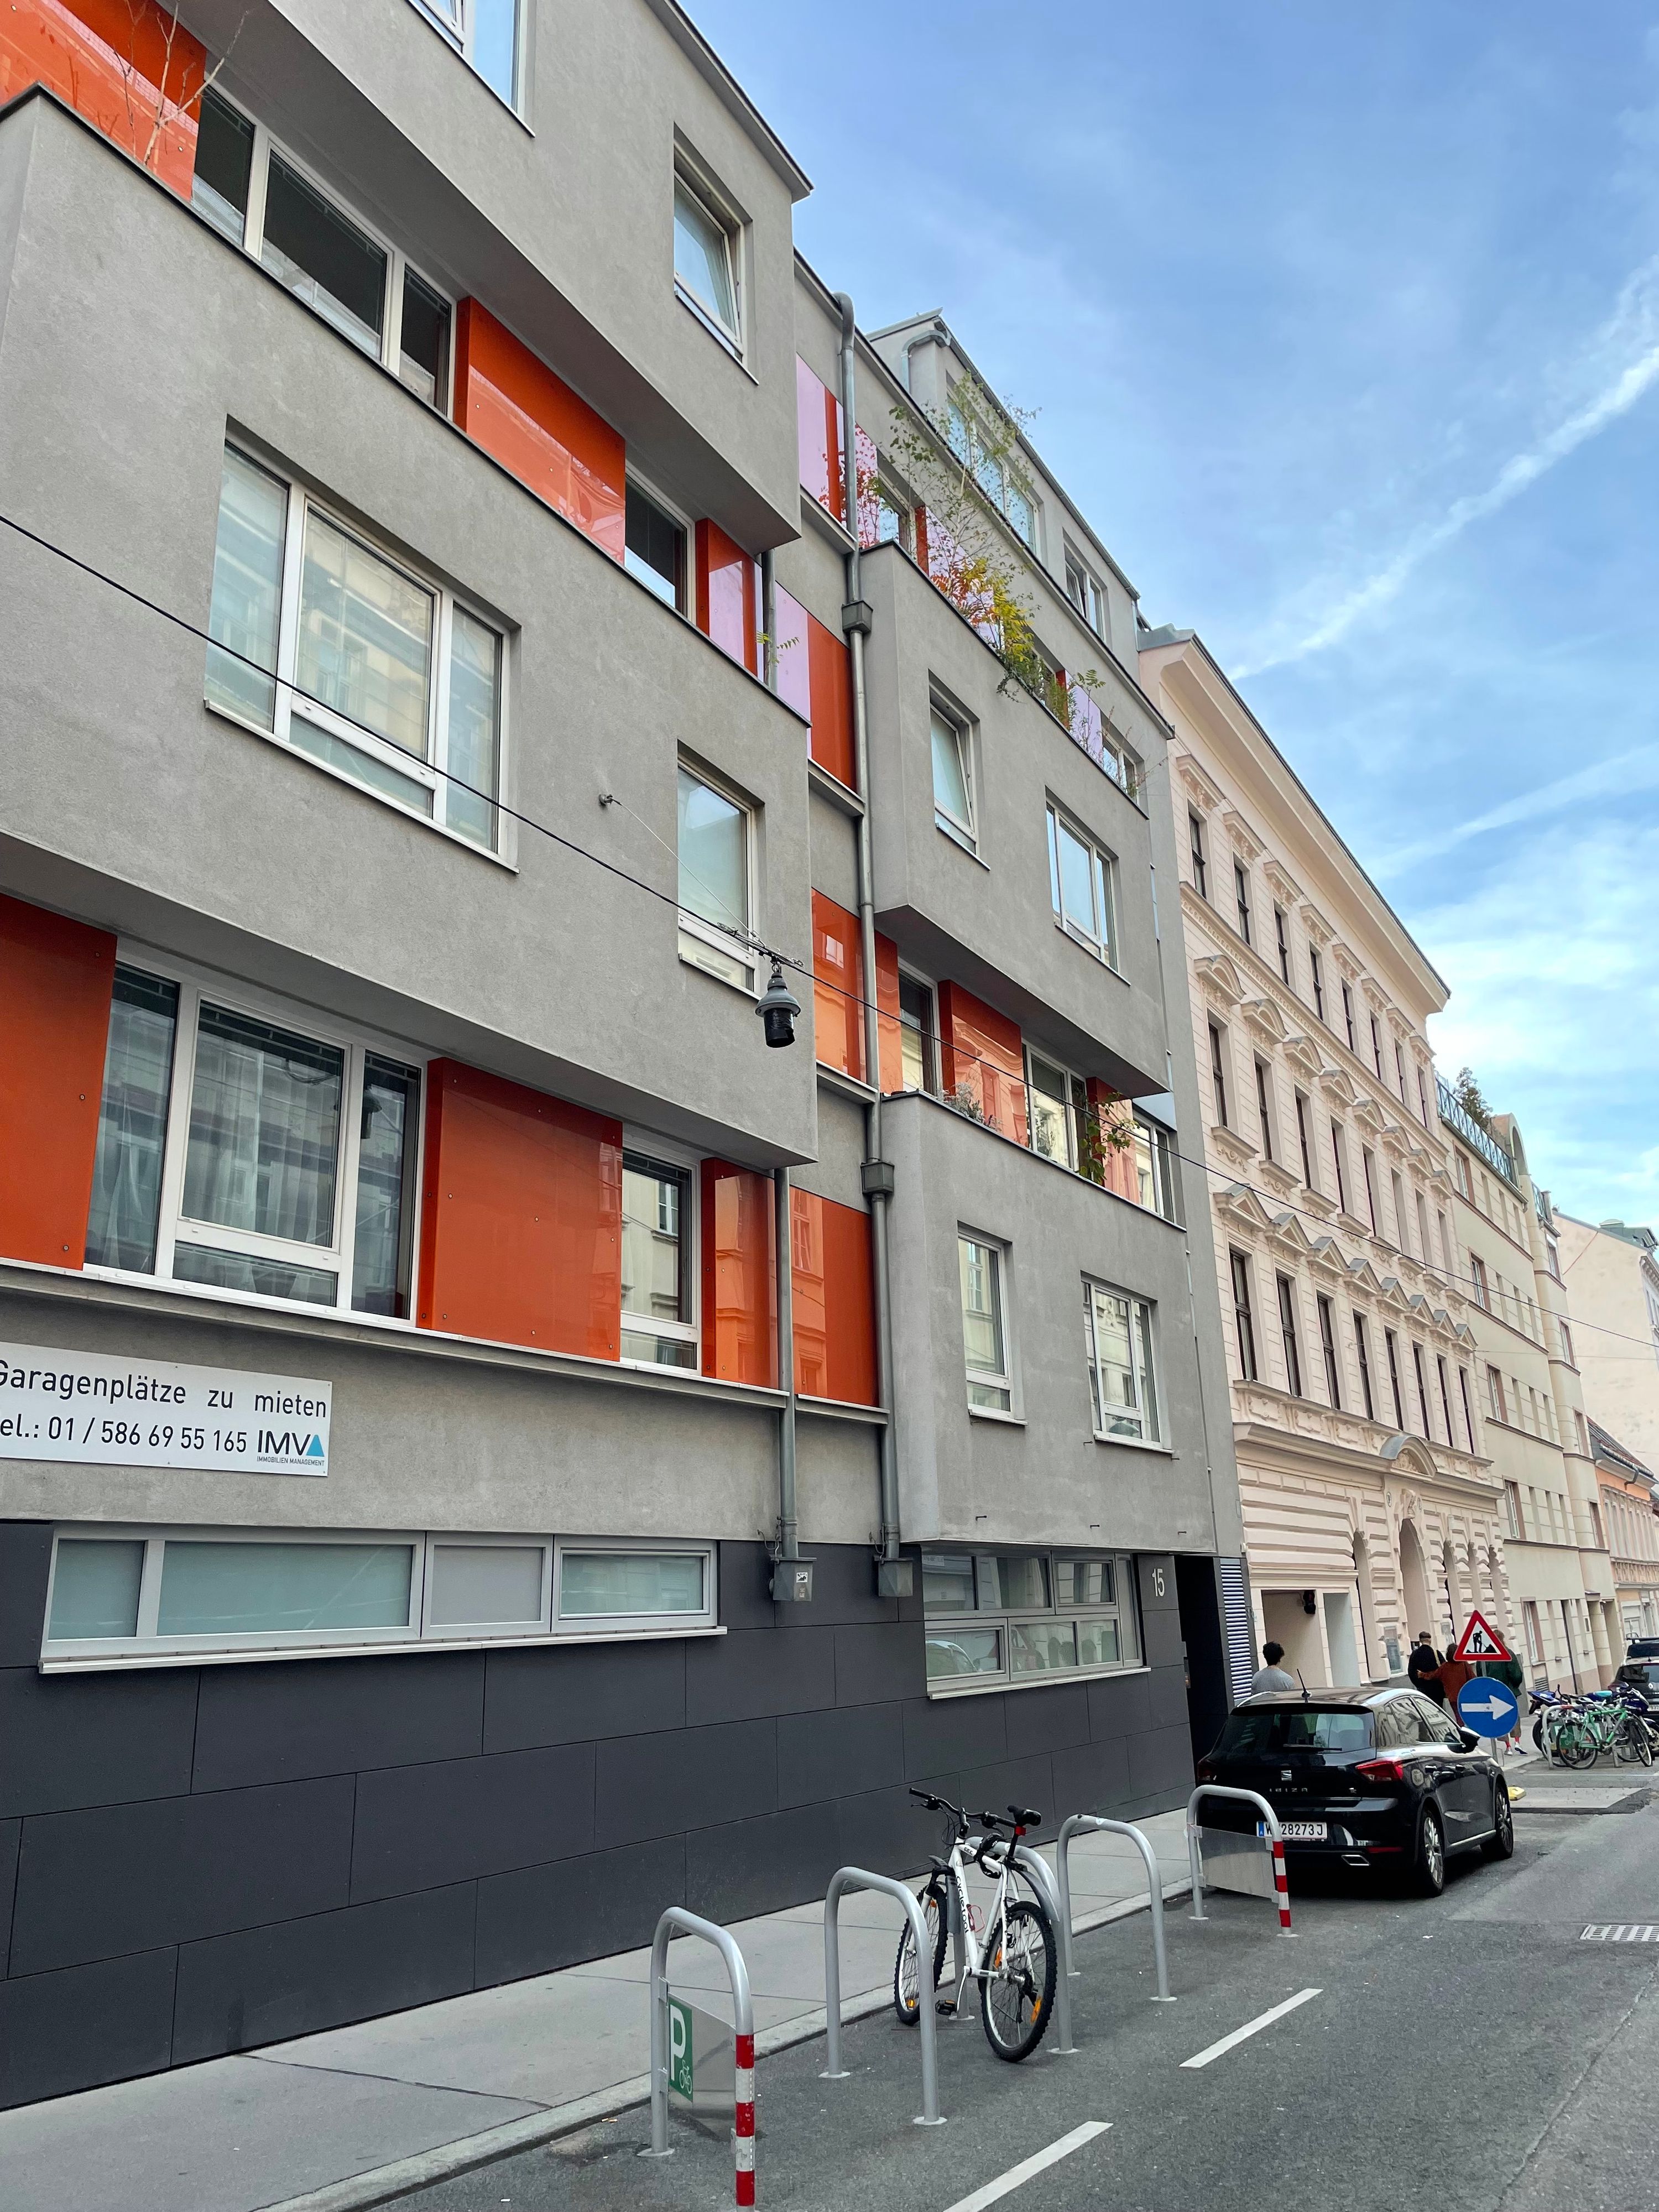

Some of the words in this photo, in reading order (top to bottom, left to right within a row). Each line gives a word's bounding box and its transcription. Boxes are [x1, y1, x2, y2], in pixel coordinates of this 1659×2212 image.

[207, 1390, 233, 1408] zu
[254, 1391, 326, 1417] mieten
[0, 1413, 39, 1438] el.:
[49, 1416, 74, 1441] 01
[82, 1417, 95, 1443] /
[101, 1421, 140, 1445] 586
[149, 1425, 173, 1447] 69
[181, 1427, 205, 1449] 55
[213, 1430, 247, 1453] 165
[289, 1458, 325, 1466] MANAGEMENT
[1152, 1568, 1165, 1597] 15
[670, 2004, 686, 2082] P
